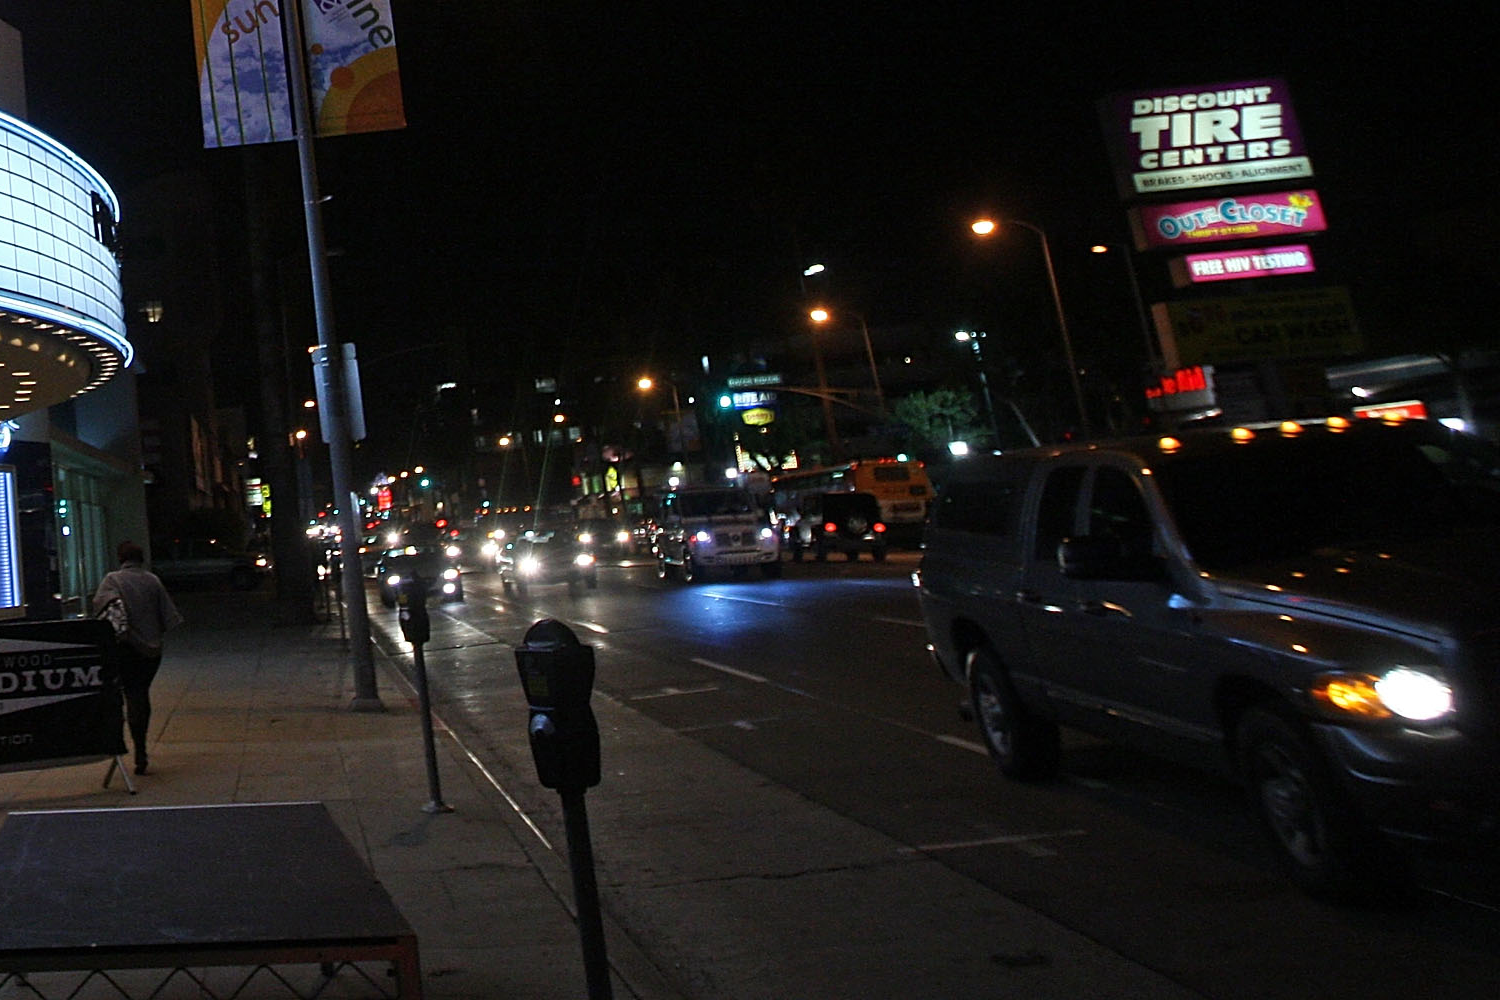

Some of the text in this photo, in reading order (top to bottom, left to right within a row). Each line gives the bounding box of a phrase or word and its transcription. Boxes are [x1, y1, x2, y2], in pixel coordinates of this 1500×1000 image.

[220, 0, 280, 45] sun
[1133, 86, 1272, 115] DISCOUNT
[1130, 103, 1284, 151] TIRE
[1139, 138, 1292, 170] CENTERS
[1142, 164, 1304, 187] BRAKES SHOCKS ALIGNMENT
[1191, 251, 1307, 277] FREE HIV TESTING
